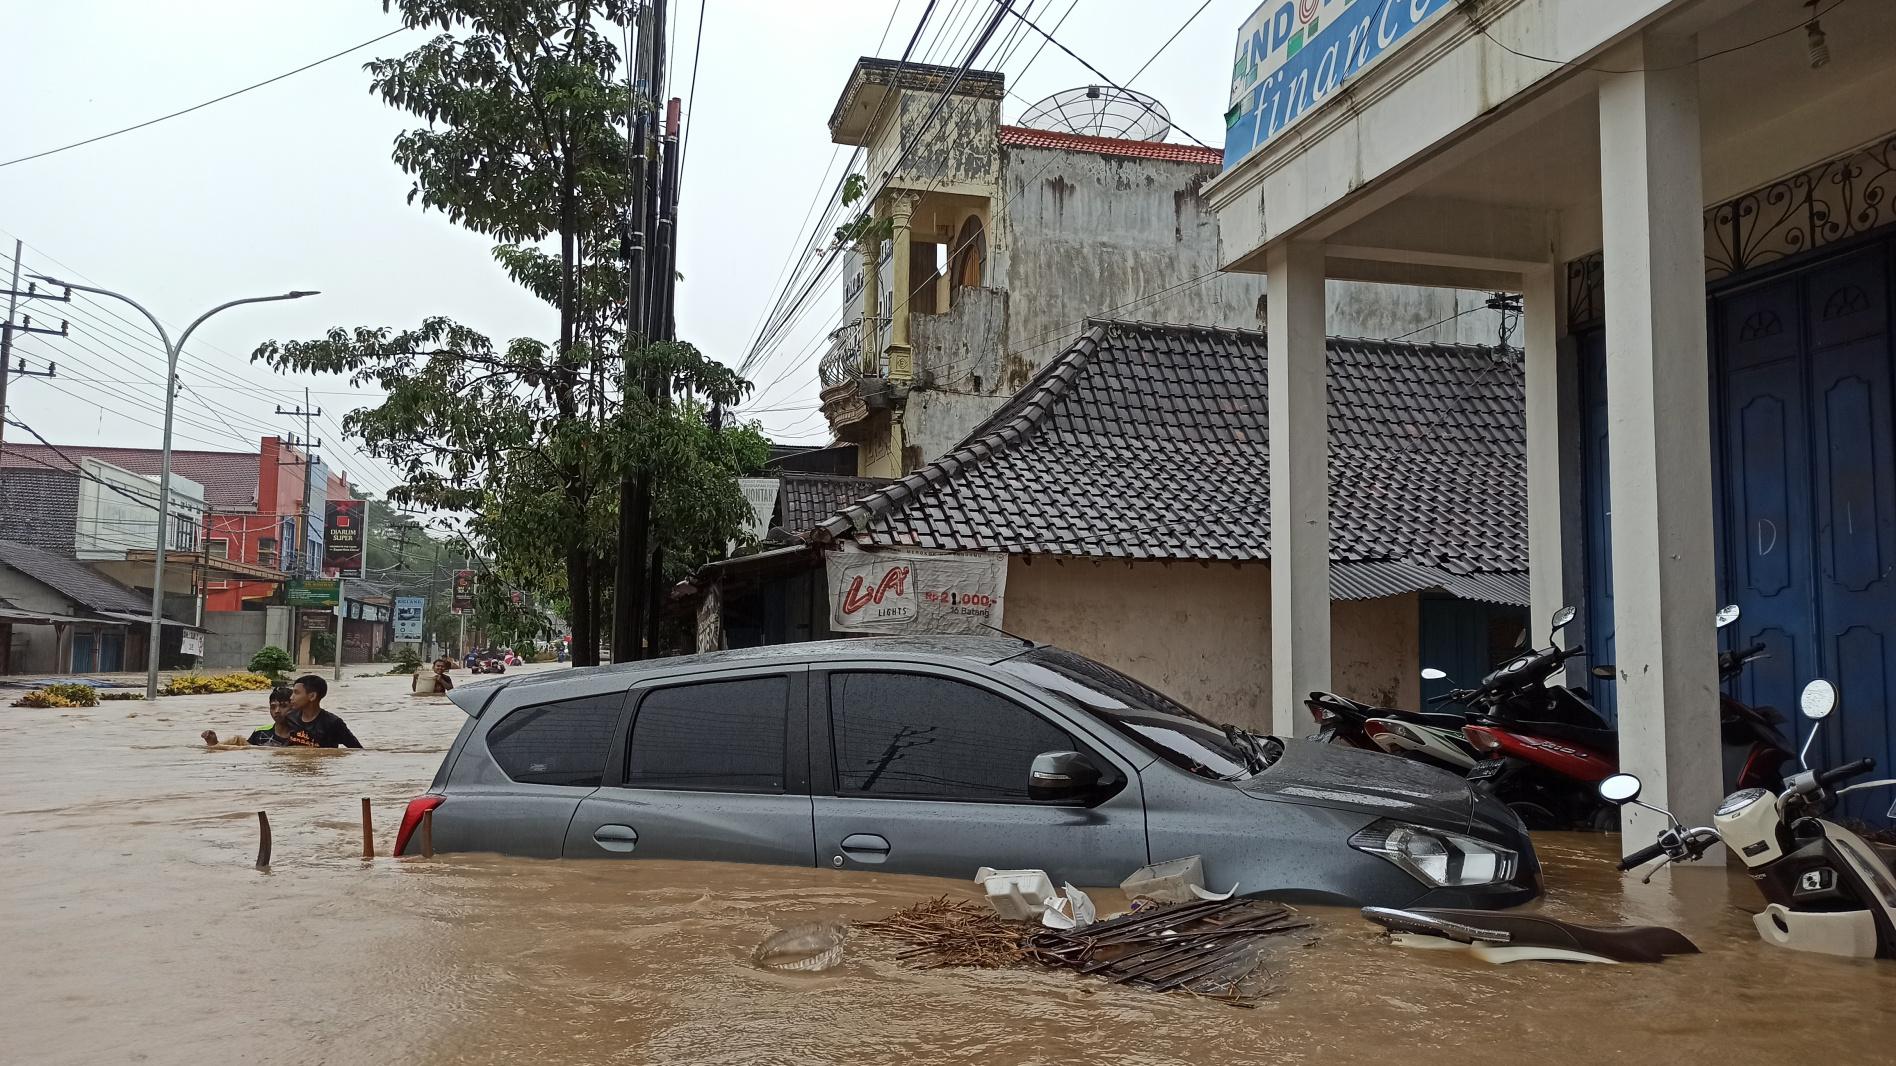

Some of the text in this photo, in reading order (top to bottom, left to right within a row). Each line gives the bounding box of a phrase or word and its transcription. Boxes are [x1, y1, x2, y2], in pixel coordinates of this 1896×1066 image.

[843, 566, 909, 615] LA
[878, 607, 907, 617] LIGHTS
[961, 607, 990, 618] Batang
